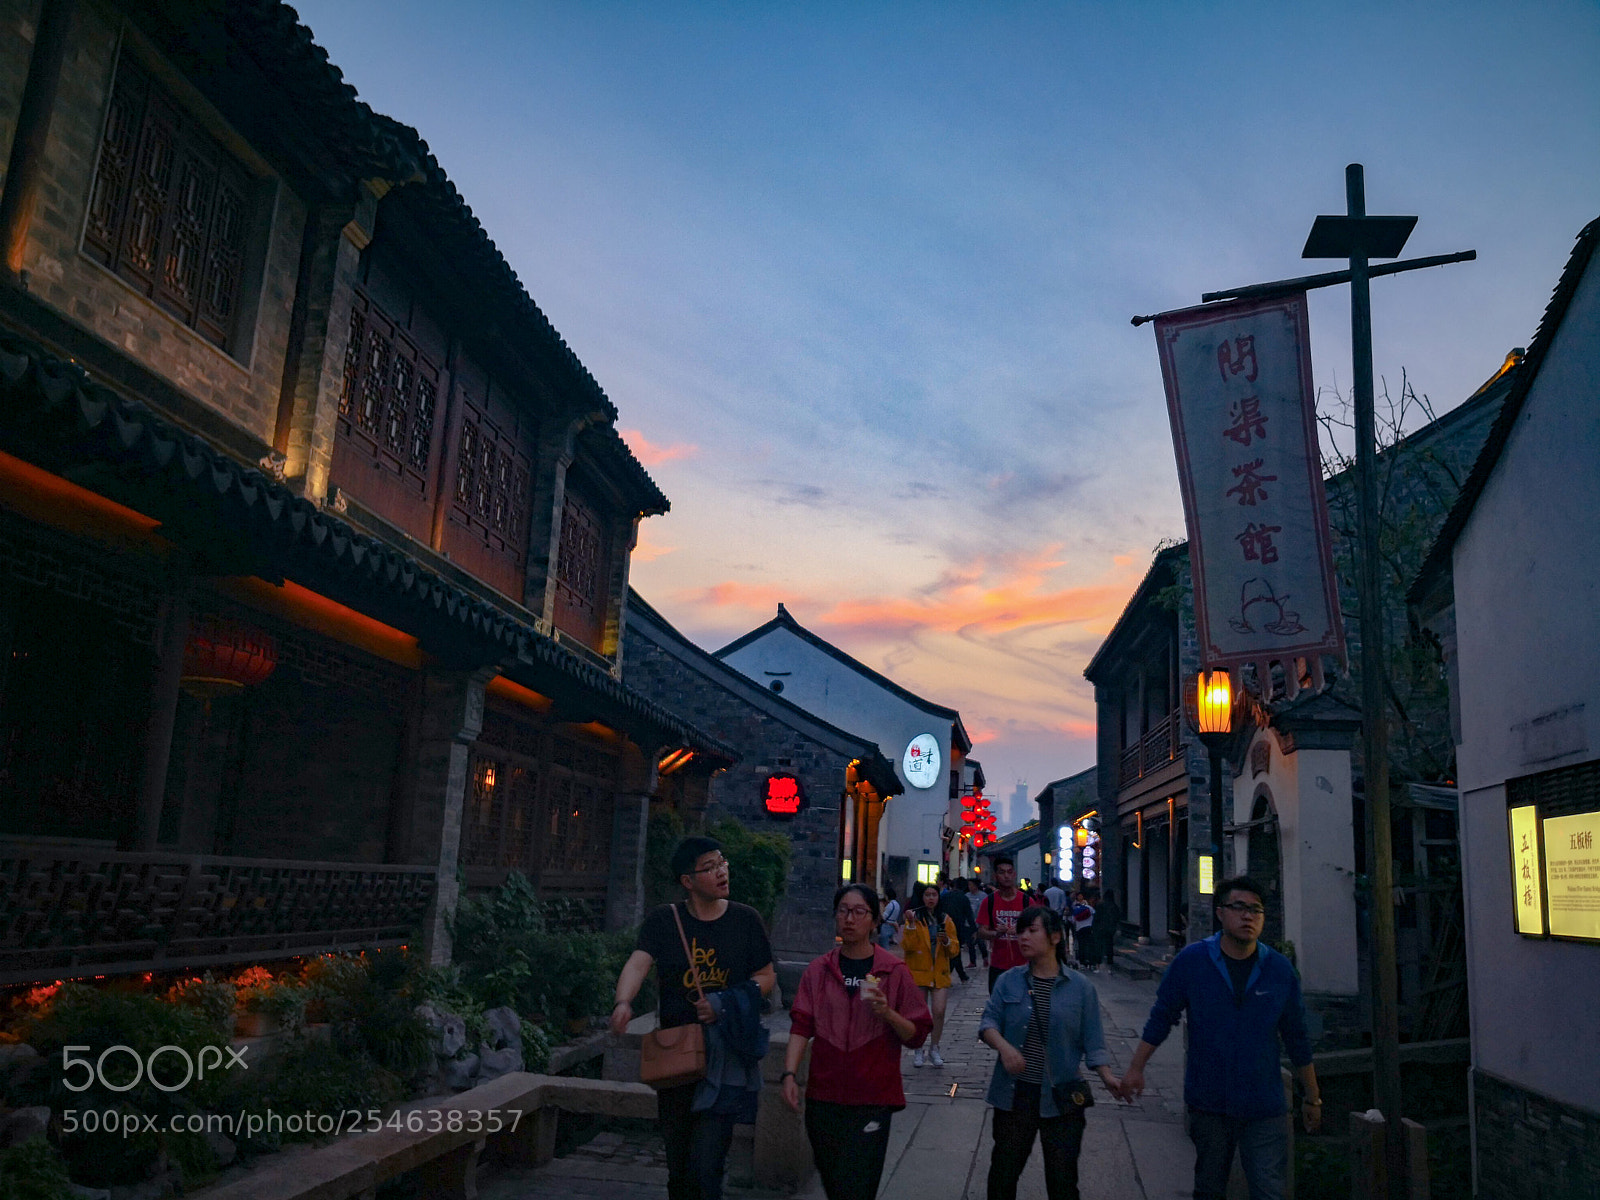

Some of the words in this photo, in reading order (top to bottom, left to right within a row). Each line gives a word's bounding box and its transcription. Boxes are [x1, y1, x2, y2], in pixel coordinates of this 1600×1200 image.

[1569, 831, 1593, 850] 五板桥
[691, 937, 717, 967] be
